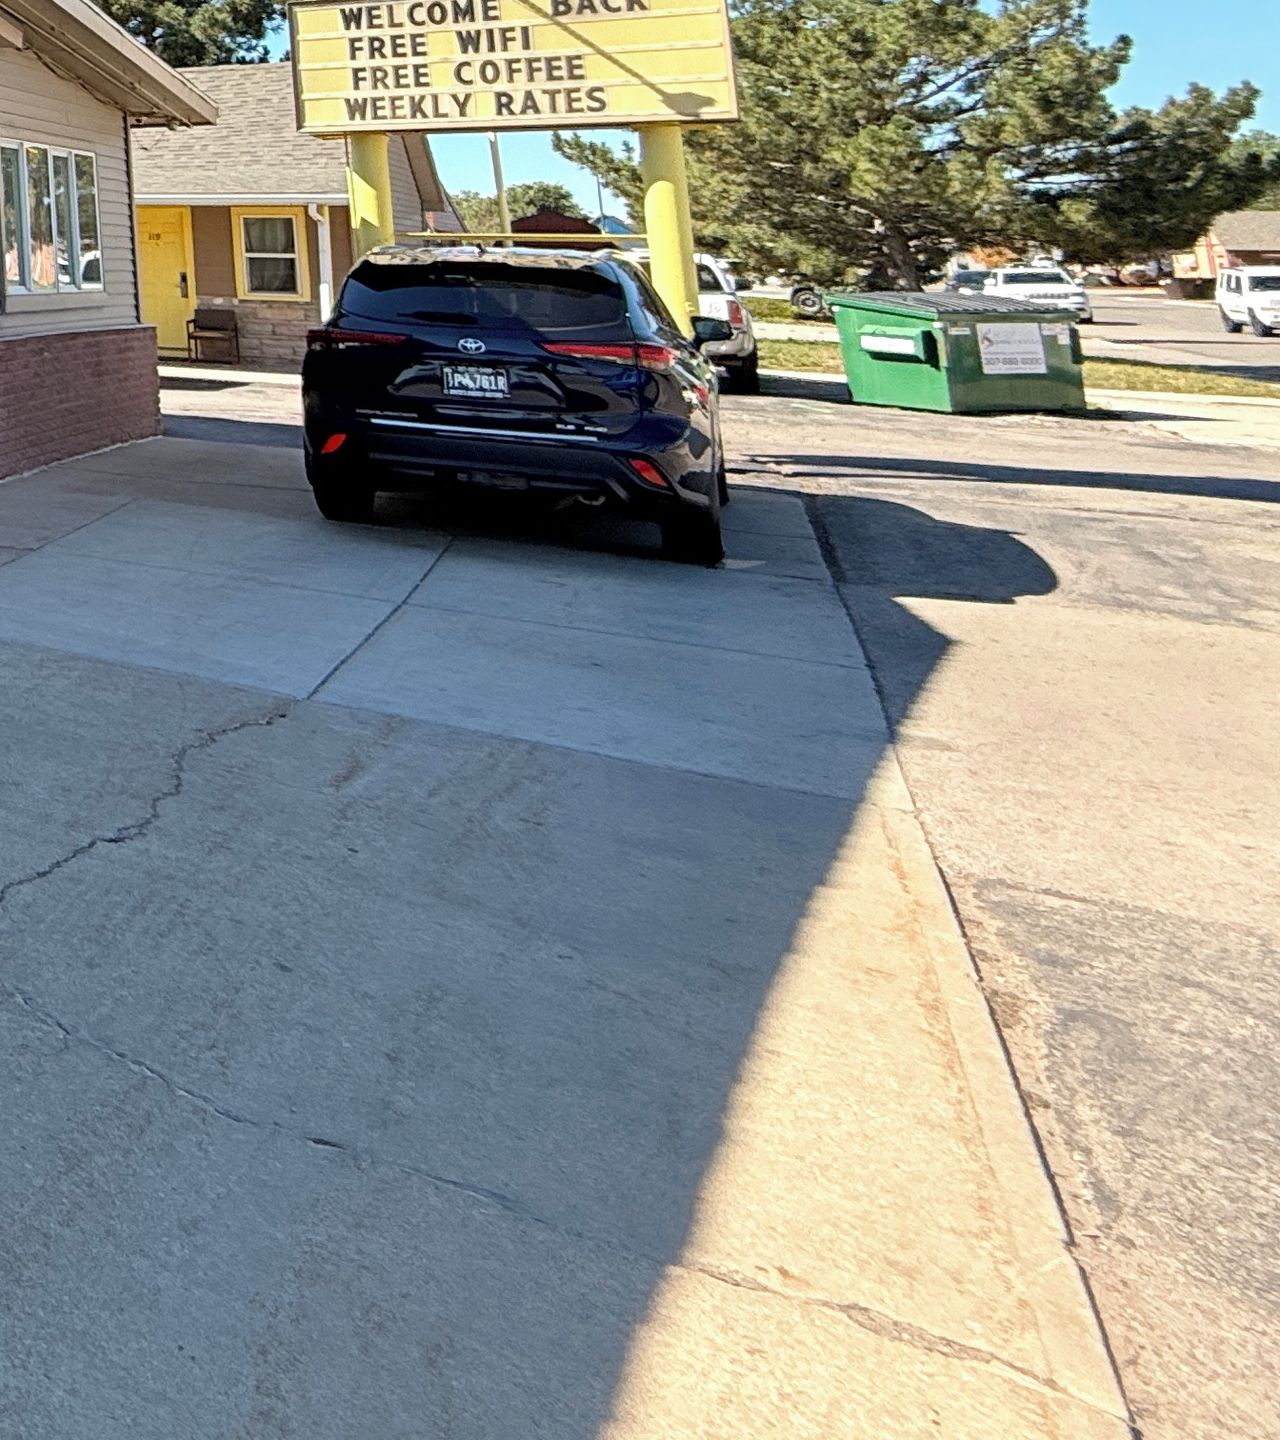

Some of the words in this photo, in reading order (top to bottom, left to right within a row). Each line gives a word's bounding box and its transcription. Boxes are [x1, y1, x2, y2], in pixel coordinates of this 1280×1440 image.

[349, 32, 427, 60] FREE
[456, 26, 531, 54] WIFI
[352, 63, 430, 90] FREE
[454, 55, 585, 85] COFFEE
[344, 93, 471, 121] WEEKLY
[496, 86, 607, 116] RATES
